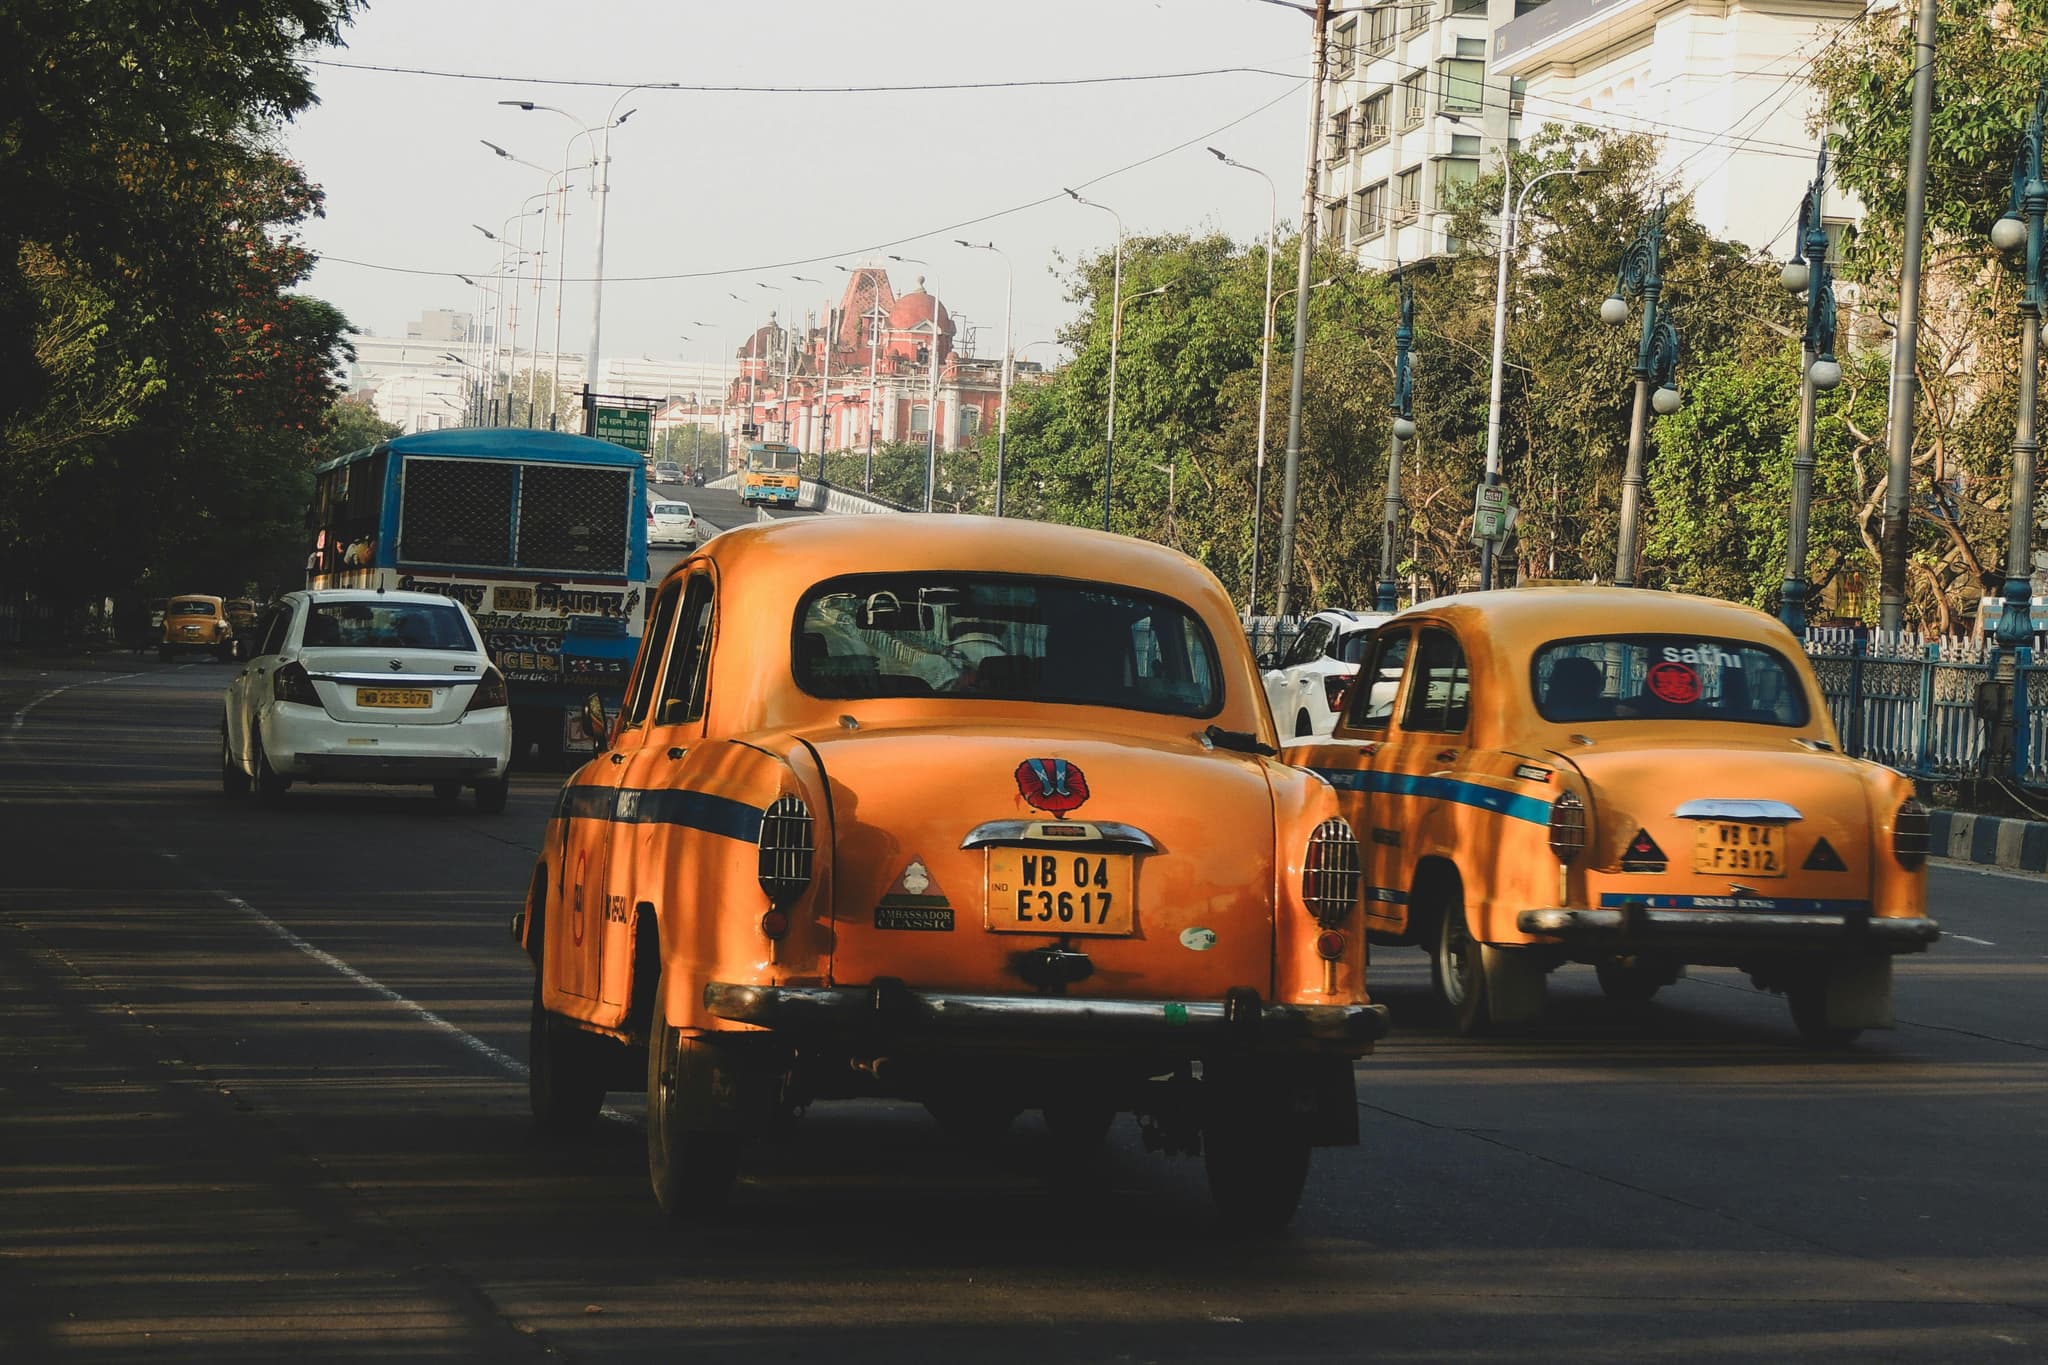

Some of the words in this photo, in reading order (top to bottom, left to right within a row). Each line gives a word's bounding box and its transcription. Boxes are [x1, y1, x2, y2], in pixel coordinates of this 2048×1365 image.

[1719, 825, 1740, 845] WB
[1749, 827, 1770, 845] 04
[1022, 855, 1057, 887] WB
[1073, 856, 1108, 889] 04
[991, 883, 1009, 892] IND
[879, 909, 952, 920] AMBASSADOR
[1016, 890, 1113, 925] E3617
[878, 919, 952, 929] CLASSIC
